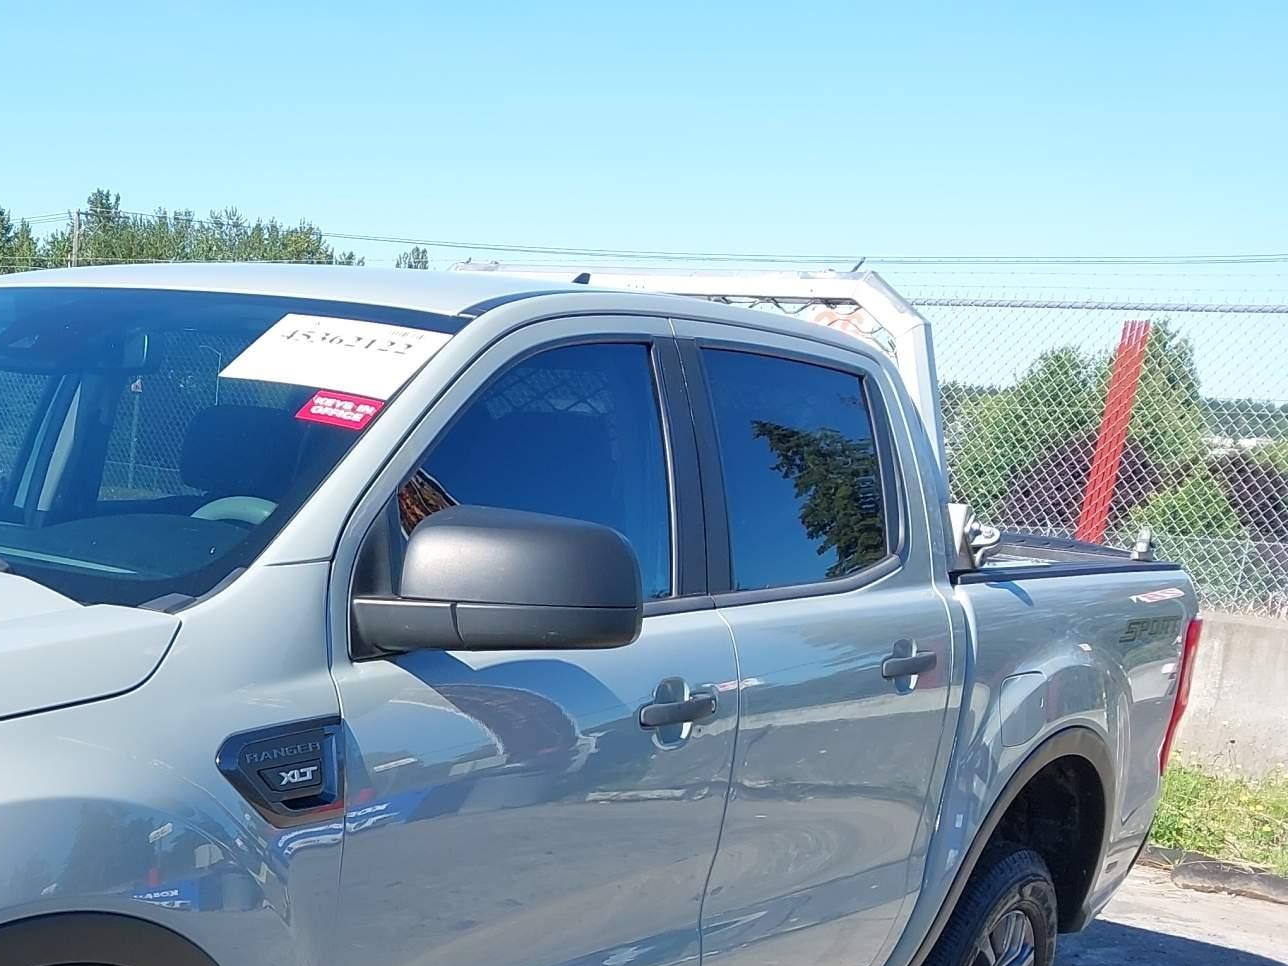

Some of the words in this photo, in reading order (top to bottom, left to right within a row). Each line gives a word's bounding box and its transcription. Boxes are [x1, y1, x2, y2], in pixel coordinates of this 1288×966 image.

[280, 329, 413, 355] 45362122
[356, 404, 377, 416] IN
[1119, 616, 1179, 643] SPORT
[245, 742, 321, 764] RANGER
[279, 766, 318, 786] XLT
